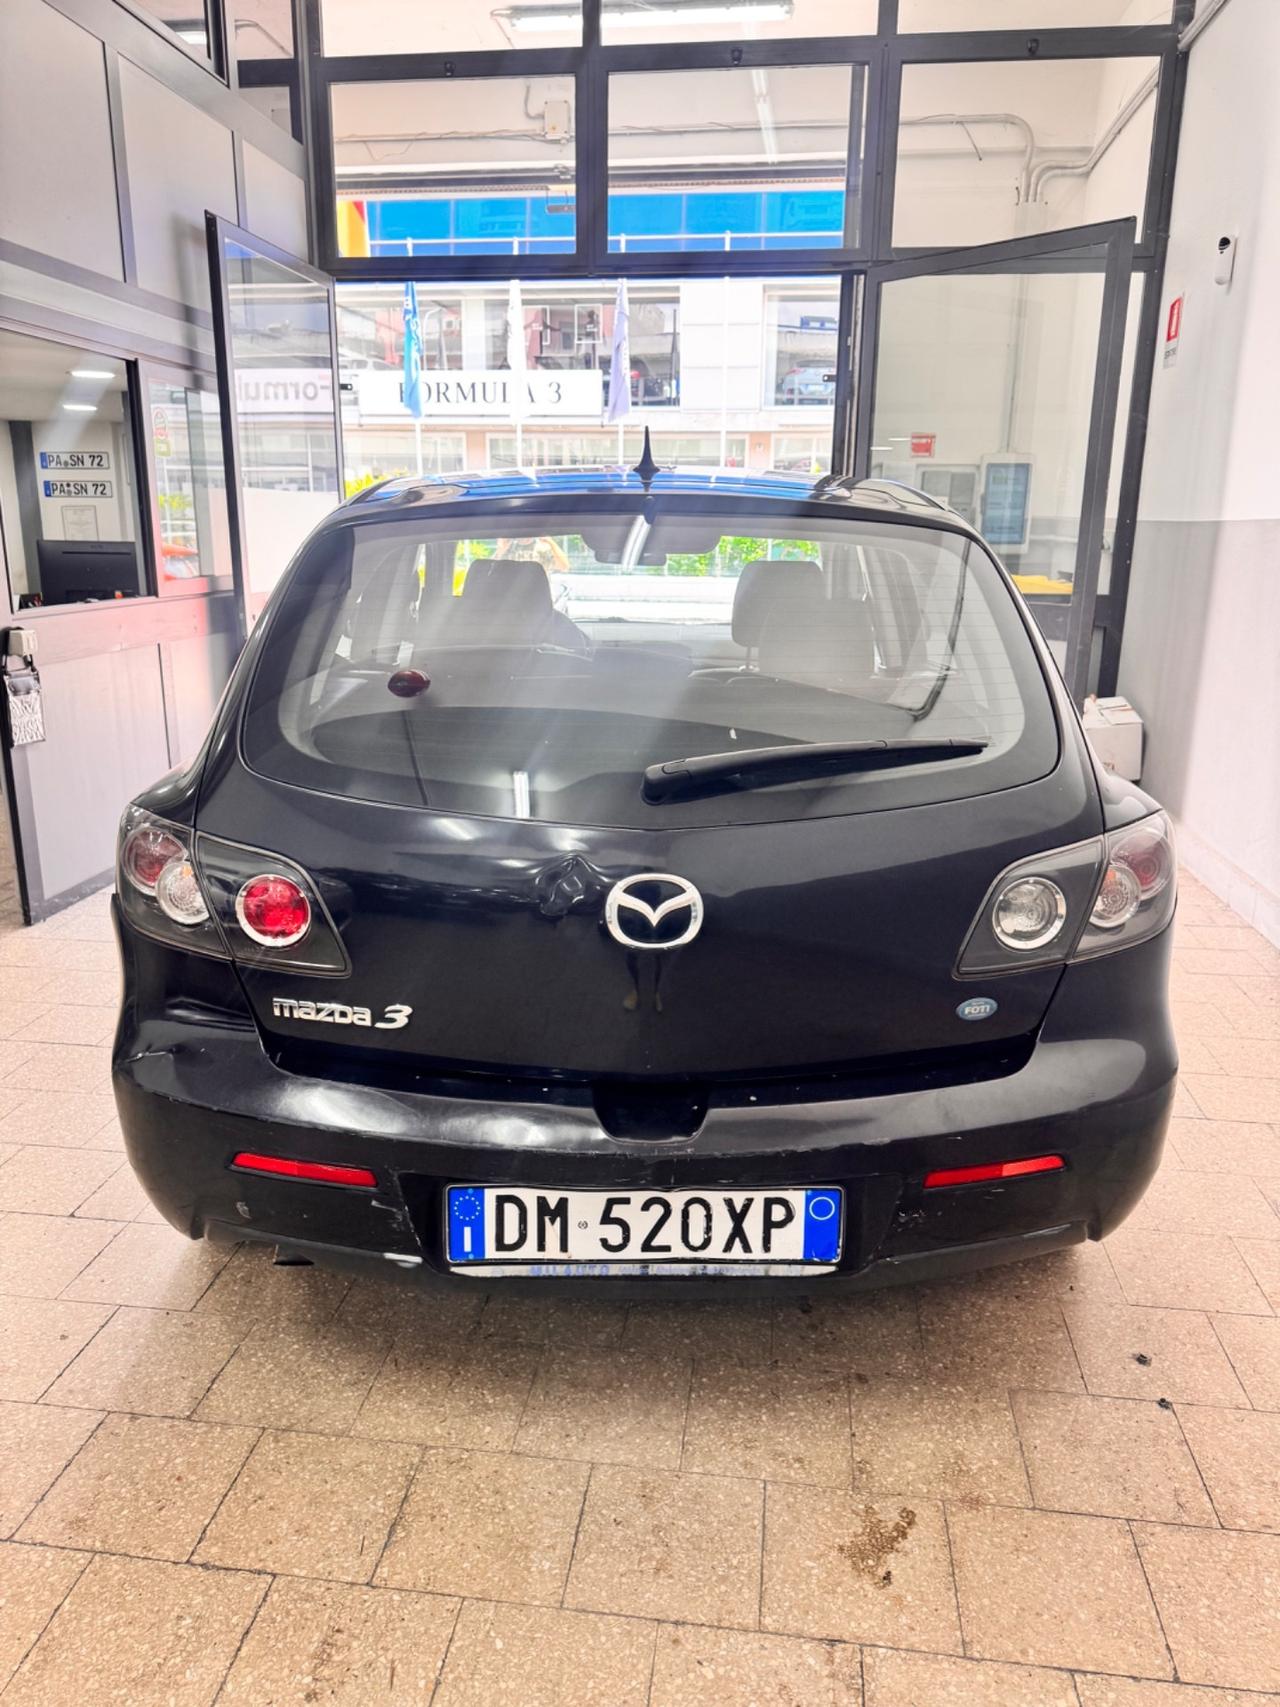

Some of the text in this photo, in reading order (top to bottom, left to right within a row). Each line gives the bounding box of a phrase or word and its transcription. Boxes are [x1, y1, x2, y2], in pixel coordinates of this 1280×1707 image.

[548, 381, 562, 404] 3
[47, 454, 104, 468] PA SN 72
[51, 482, 107, 496] PA SN 72
[374, 1003, 413, 1029] 3
[494, 1193, 569, 1253] DM
[599, 1194, 797, 1254] 520XP
